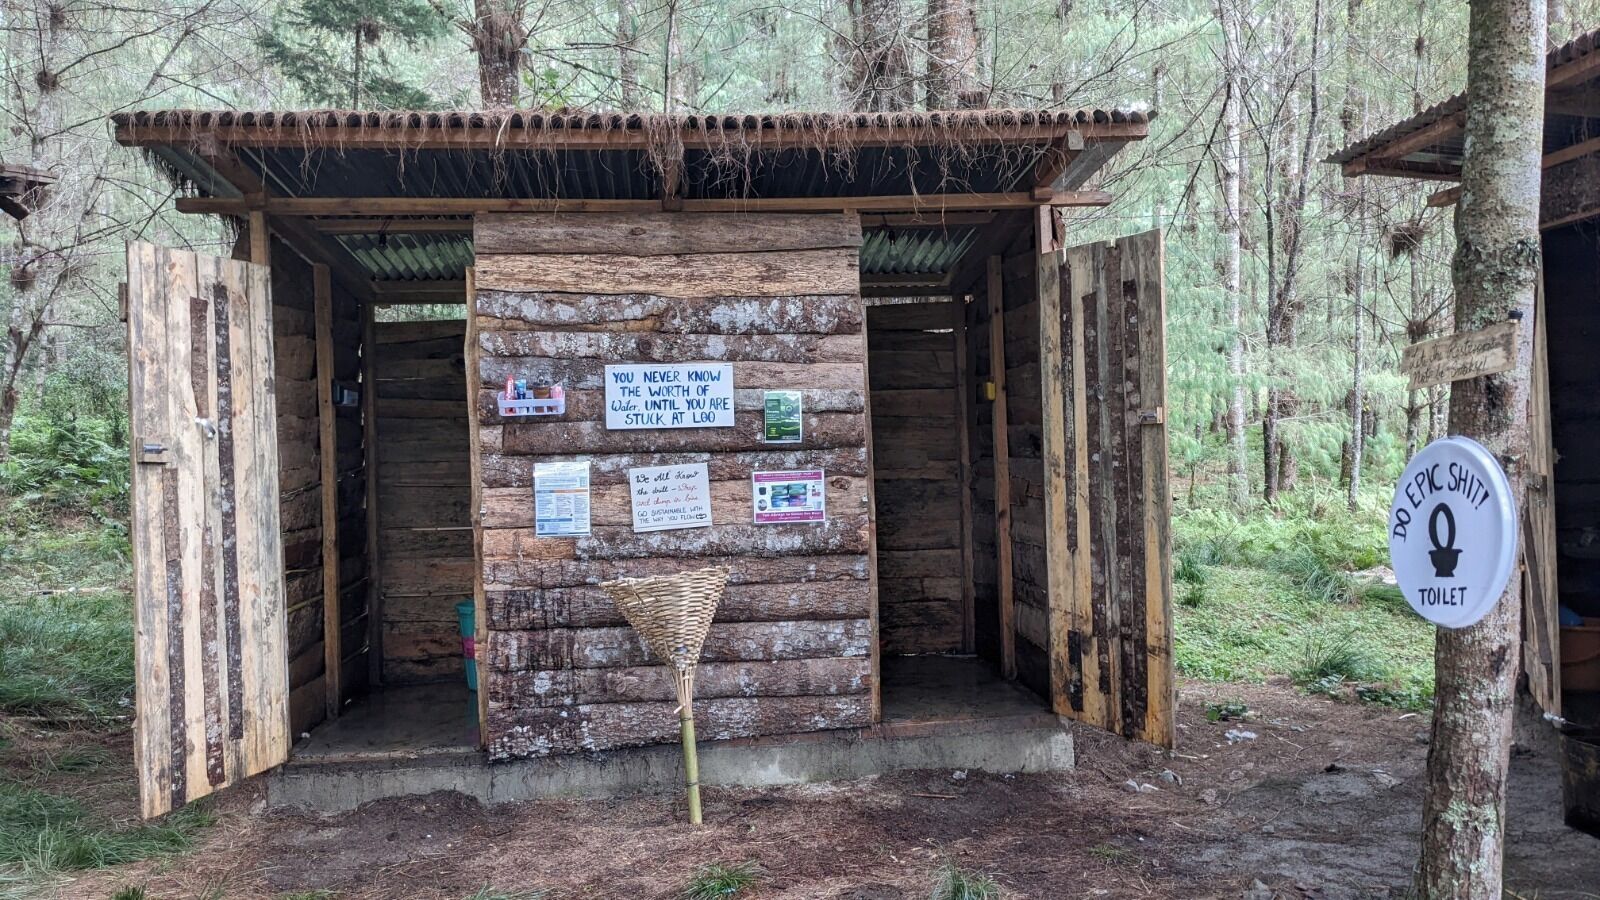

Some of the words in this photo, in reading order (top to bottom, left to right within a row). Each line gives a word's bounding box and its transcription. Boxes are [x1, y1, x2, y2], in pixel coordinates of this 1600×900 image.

[612, 372, 634, 384] YOU
[643, 370, 681, 383] NEVER
[687, 370, 721, 382] KNOW
[620, 386, 642, 398] THE
[648, 385, 690, 398] WORTH
[696, 384, 710, 397] OF
[645, 399, 681, 411] UNTIL
[686, 399, 706, 410] YOU
[709, 397, 730, 410] ARE
[624, 412, 667, 426] STUCK
[671, 412, 685, 425] AT
[692, 411, 716, 424] LOO
[635, 474, 650, 483] We
[675, 471, 699, 480] Know
[636, 487, 649, 496] the
[652, 485, 669, 495] drill
[1393, 507, 1412, 542] DO
[1405, 463, 1443, 510] EPIC
[1447, 462, 1490, 511] SHIT!
[651, 506, 687, 517] SUSTAINABLE
[689, 505, 704, 513] WITH
[638, 517, 651, 525] THE
[1418, 586, 1467, 606] TOILET
